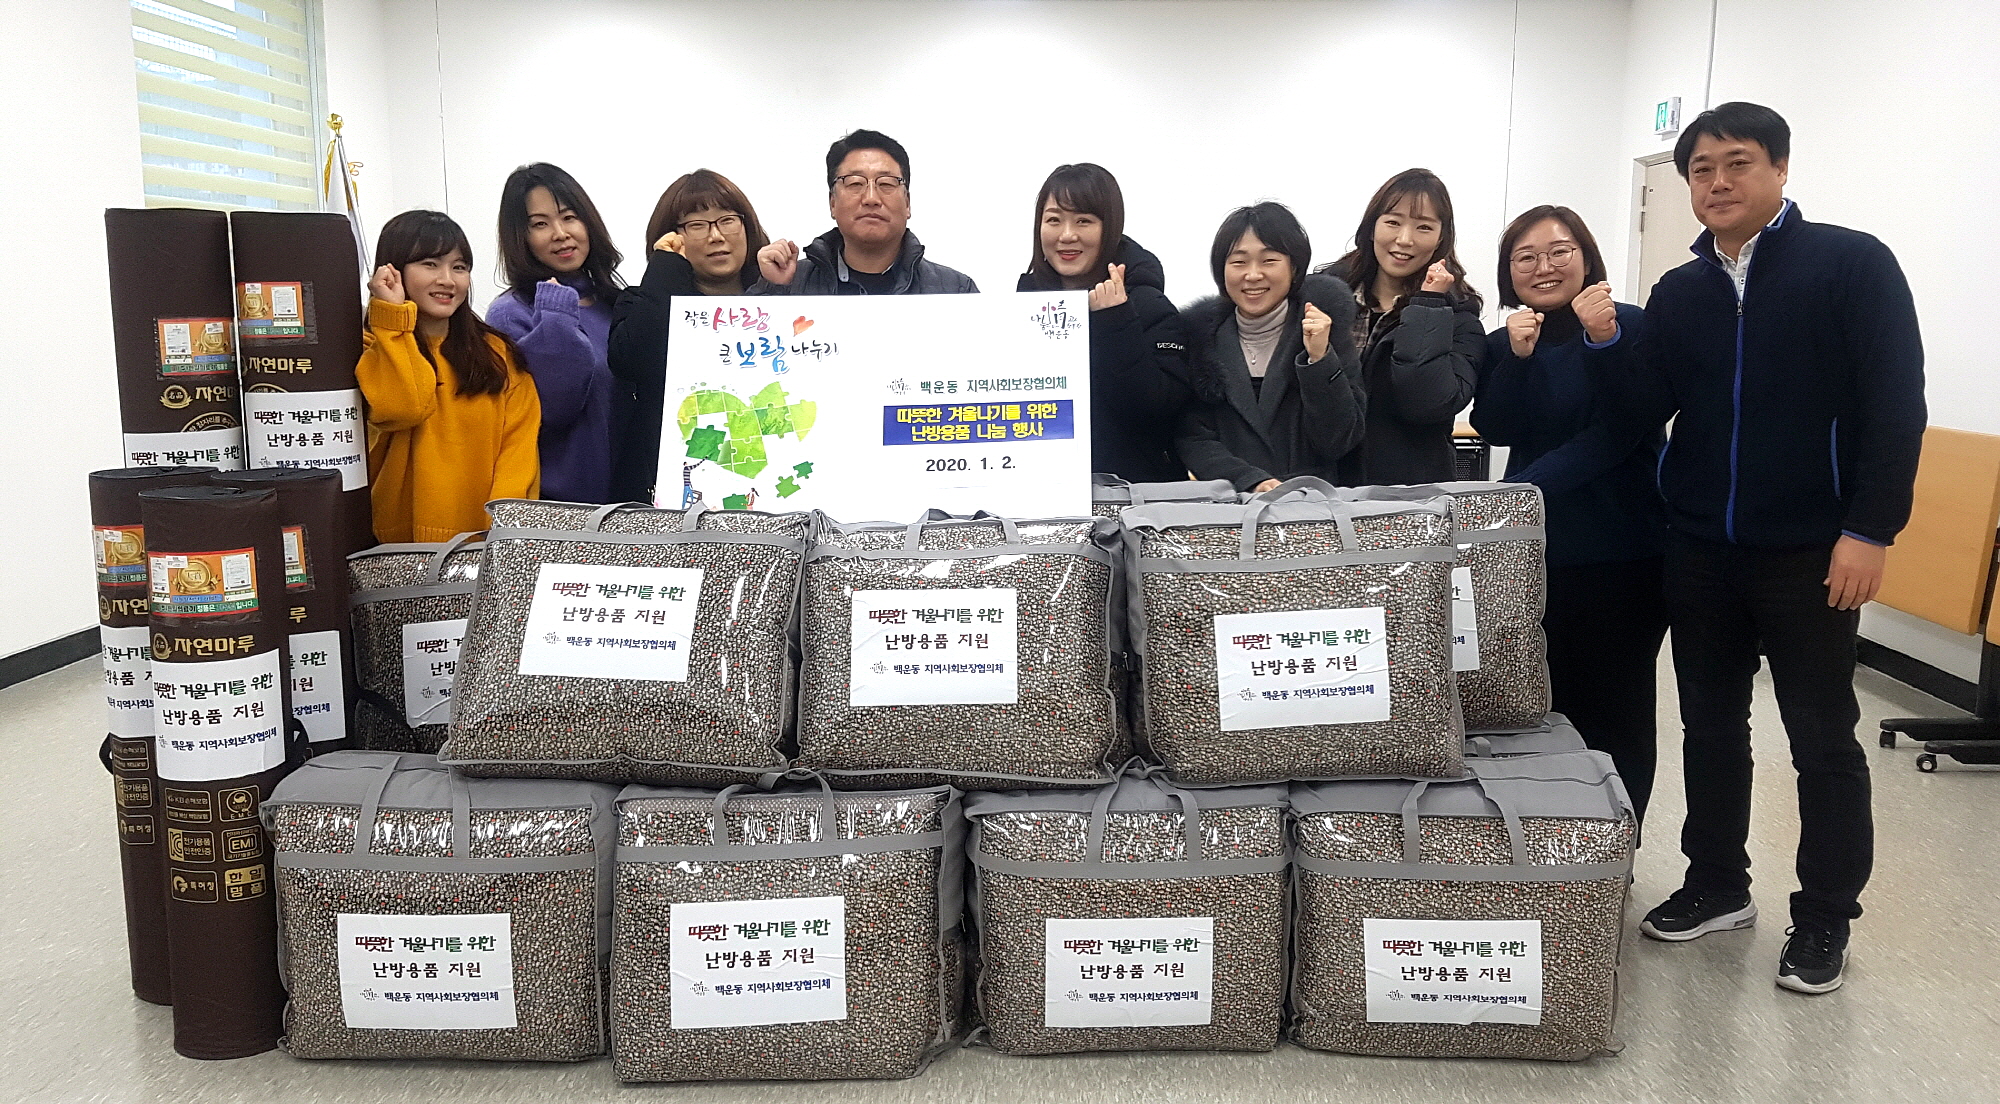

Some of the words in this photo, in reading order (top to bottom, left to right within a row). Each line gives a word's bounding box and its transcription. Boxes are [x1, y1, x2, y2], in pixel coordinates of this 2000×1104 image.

[685, 310, 709, 326] 작은
[713, 307, 769, 330] 사랑
[720, 344, 730, 363] 큰
[736, 336, 788, 372] 보람
[249, 357, 312, 374] 자연마루
[920, 380, 958, 394] 백운동
[967, 376, 1067, 392] 지역사회보장협의체
[254, 411, 284, 424] 따뜻한
[288, 409, 342, 424] 겨울나기를
[344, 406, 358, 420] 위한
[896, 406, 942, 424] 따뜻한
[948, 404, 1021, 422] 겨울나기를
[1026, 403, 1058, 420] 위한
[267, 432, 324, 447] 난방용품
[332, 430, 354, 443] 지원
[911, 424, 970, 442] 난방용품
[976, 423, 1006, 439] 나눔
[1012, 422, 1044, 438] 행사
[132, 452, 158, 466] 따뜻한
[162, 449, 220, 464] 겨울나기를
[224, 445, 240, 460] 위한
[304, 454, 361, 468] 지역사회보장협의체
[926, 458, 971, 472] 2020.
[980, 458, 994, 470] 1.
[1002, 456, 1016, 469] 2.
[552, 582, 590, 598] 따뜻한
[596, 584, 654, 600] 겨울나기를
[658, 586, 686, 601] 위한
[563, 607, 626, 623] 난방용품
[634, 610, 666, 624] 지원
[869, 608, 907, 624] 따뜻한
[912, 608, 972, 624] 겨울나기를
[976, 608, 1004, 624] 위한
[174, 635, 255, 656] 자연마루
[416, 638, 449, 653] 따뜻한
[566, 636, 592, 646] 백운동
[596, 638, 676, 650] 지역사회보장협의체
[886, 634, 948, 650] 난방용품
[958, 634, 988, 649] 지원
[1232, 634, 1272, 650] 따뜻한
[1276, 630, 1339, 648] 겨울나기를
[1344, 628, 1371, 644] 위한
[300, 651, 328, 666] 위한
[1252, 658, 1316, 676] 난방용품
[1326, 654, 1358, 671] 지원
[894, 664, 920, 674] 백운동
[924, 664, 1004, 674] 지역사회보장협의체
[154, 682, 177, 699] 따뜻한
[180, 680, 246, 700] 겨울나기를
[250, 672, 274, 690] 위한
[1262, 690, 1289, 700] 백운동
[1294, 684, 1374, 699] 지역사회보장협의체
[162, 709, 222, 726] 난방용품
[232, 701, 264, 718] 지원
[171, 740, 195, 751] 백운동
[199, 727, 277, 750] 지역사회보장협의체
[232, 838, 254, 850] EMI
[688, 924, 729, 941] 따뜻한
[734, 921, 798, 939] 겨울나기를
[802, 919, 830, 936] 위한
[355, 936, 394, 952] 따뜻한
[399, 936, 462, 952] 겨울나기를
[467, 936, 496, 952] 위한
[1064, 940, 1103, 954] 따뜻한
[1108, 938, 1169, 954] 겨울나기를
[1172, 938, 1200, 952] 위한
[1383, 940, 1424, 956] 따뜻한
[1428, 941, 1494, 957] 겨울나기를
[1498, 941, 1528, 957] 위한
[706, 950, 772, 969] 난방용품
[782, 948, 814, 964] 지원
[373, 962, 438, 978] 난방용품
[448, 962, 482, 978] 지원
[1080, 964, 1144, 979] 난방용품
[1154, 962, 1184, 978] 지원
[1401, 966, 1468, 982] 난방용품
[1478, 967, 1512, 982] 지원
[715, 984, 743, 995] 백운동
[748, 978, 830, 994] 지역사회보장협의체
[384, 992, 412, 1002] 백운동
[416, 992, 499, 1002] 지역사회보장협의체
[1088, 992, 1115, 1002] 백운동
[1120, 991, 1198, 1002] 지역사회보장협의체
[1410, 994, 1439, 1002] 백운동
[1443, 994, 1527, 1004] 지역사회보장협의체
